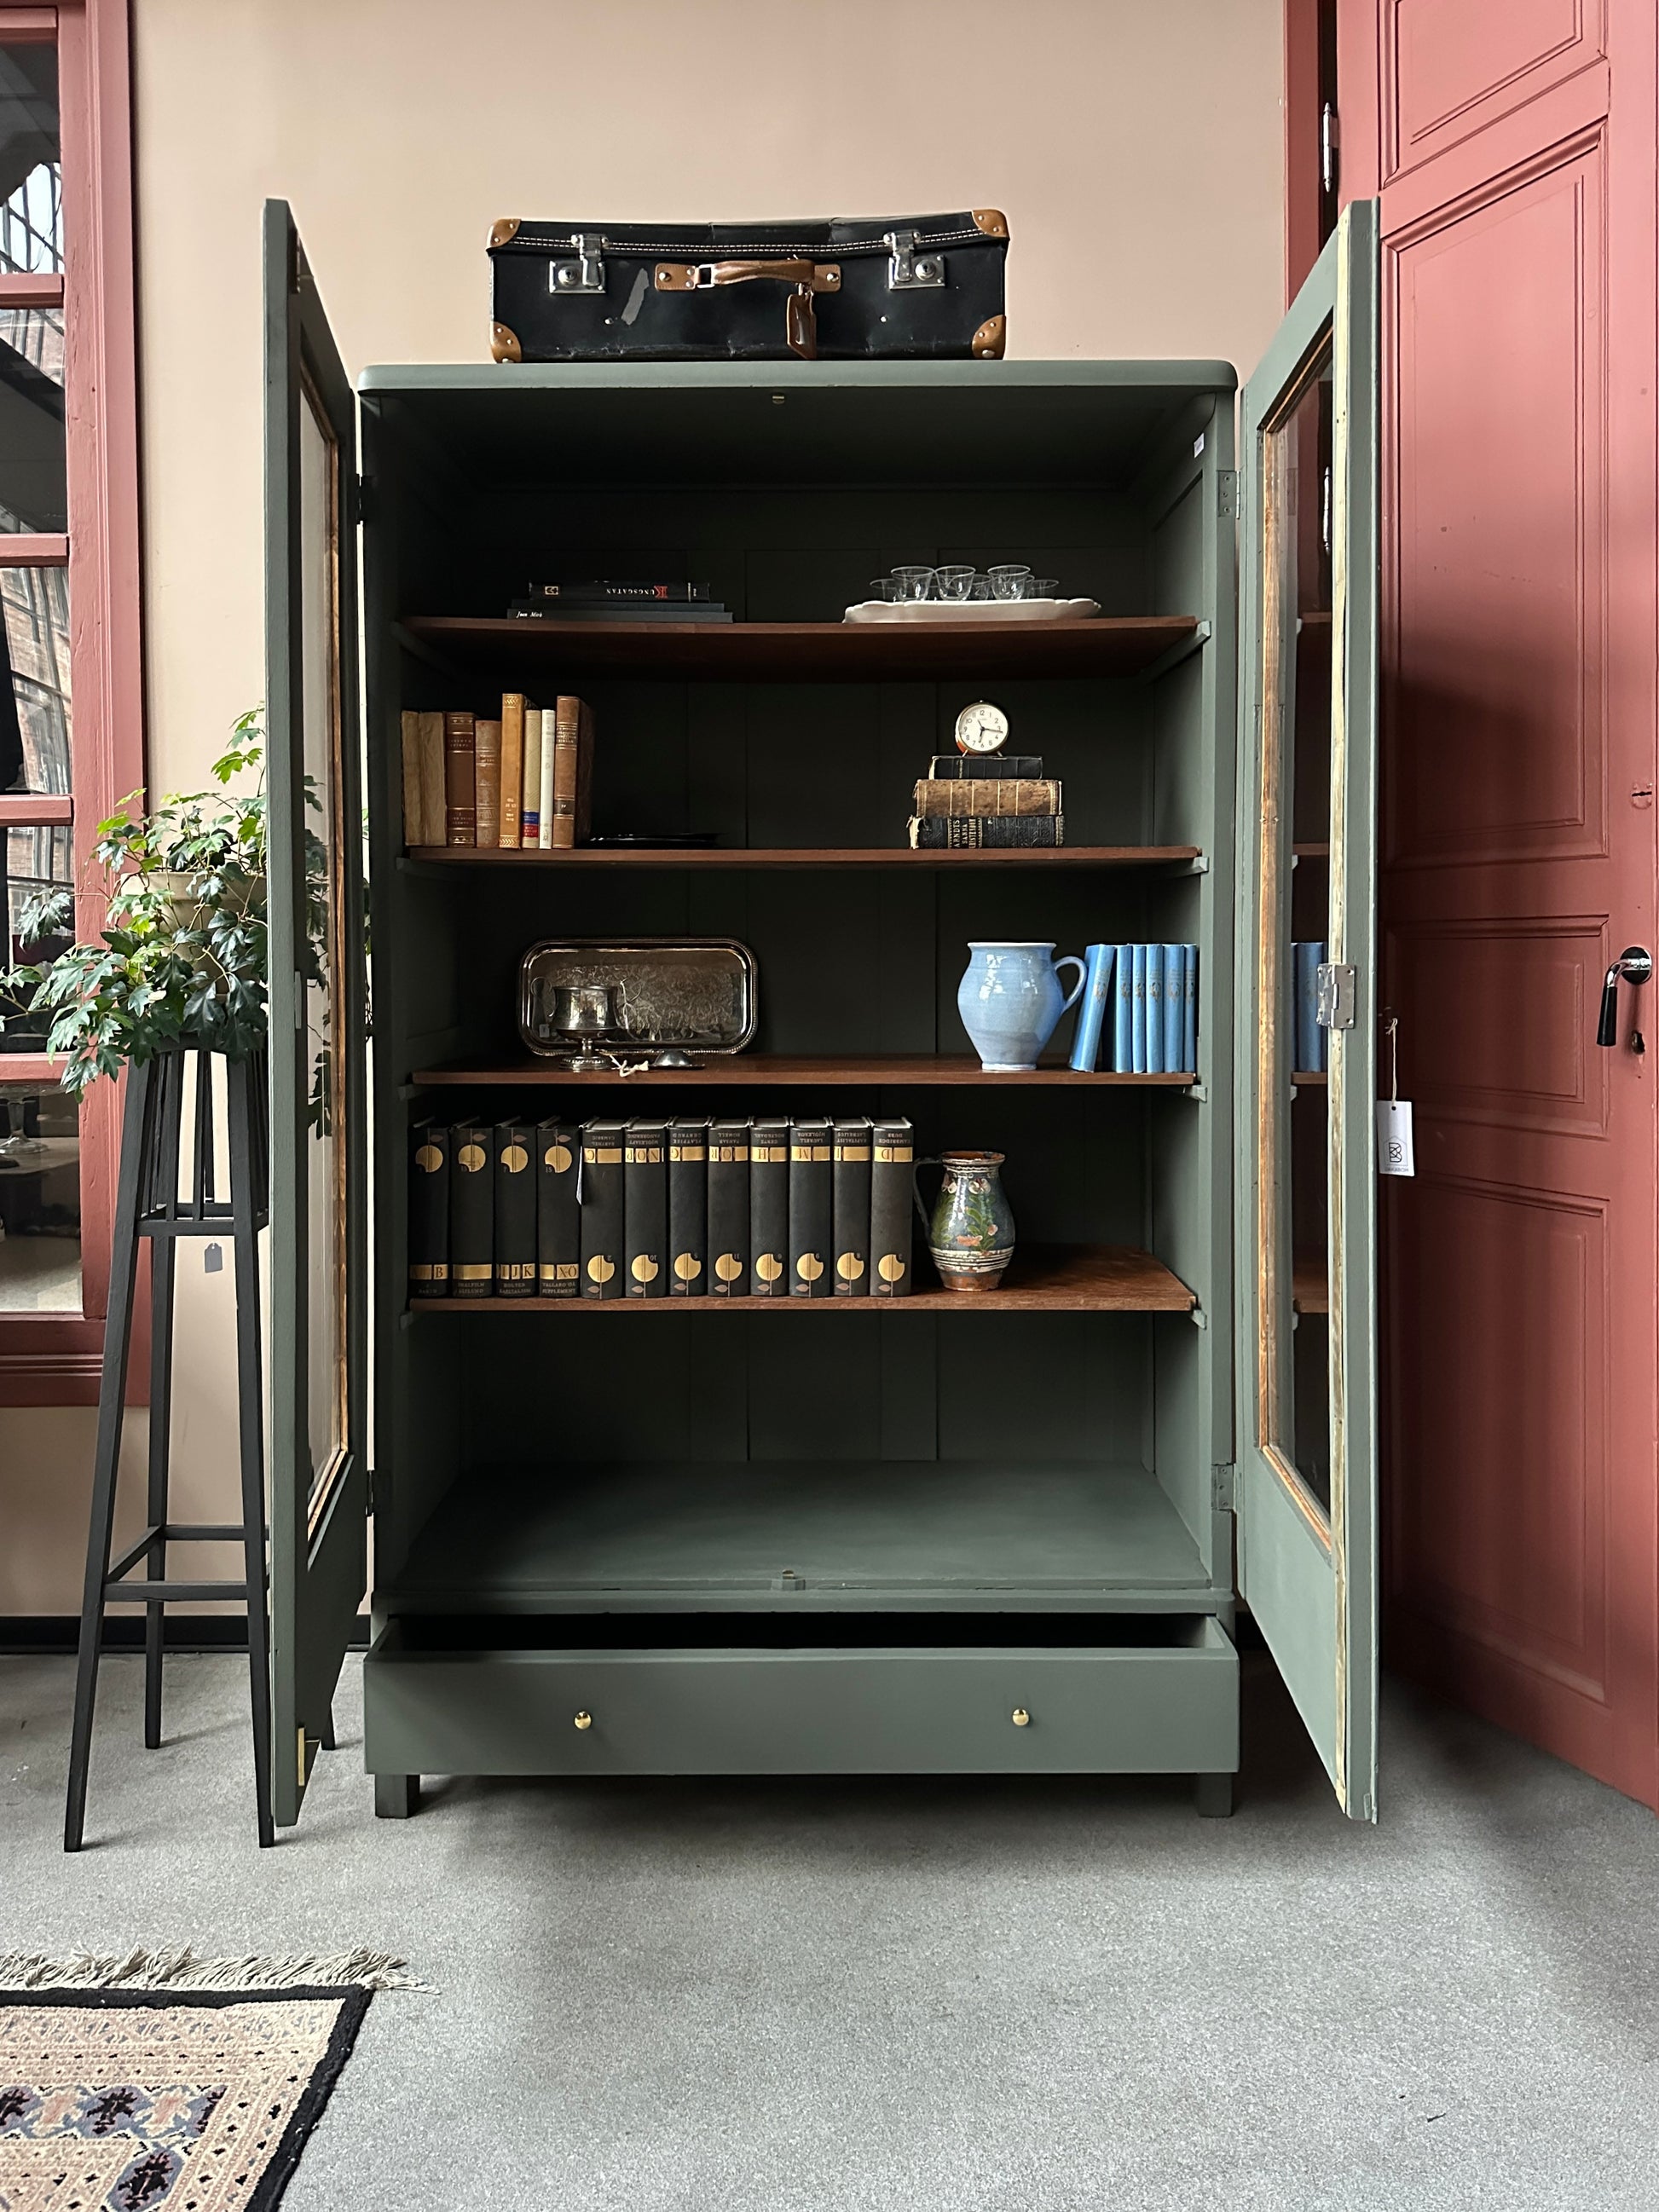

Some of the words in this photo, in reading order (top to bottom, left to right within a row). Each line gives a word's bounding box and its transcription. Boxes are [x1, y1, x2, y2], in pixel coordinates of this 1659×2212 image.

[606, 586, 668, 598] KUNGSGATAN
[587, 1149, 595, 1160] C
[627, 1149, 633, 1160] P
[637, 1149, 645, 1160] O
[650, 1149, 659, 1160] N
[671, 1148, 679, 1159] G
[711, 1148, 718, 1159] R
[758, 1148, 767, 1159] H
[799, 1148, 808, 1159] M
[881, 1148, 889, 1160] D
[436, 1266, 443, 1278] B
[512, 1265, 518, 1278] J
[523, 1265, 533, 1278] K
[558, 1265, 577, 1278] X-Ö
